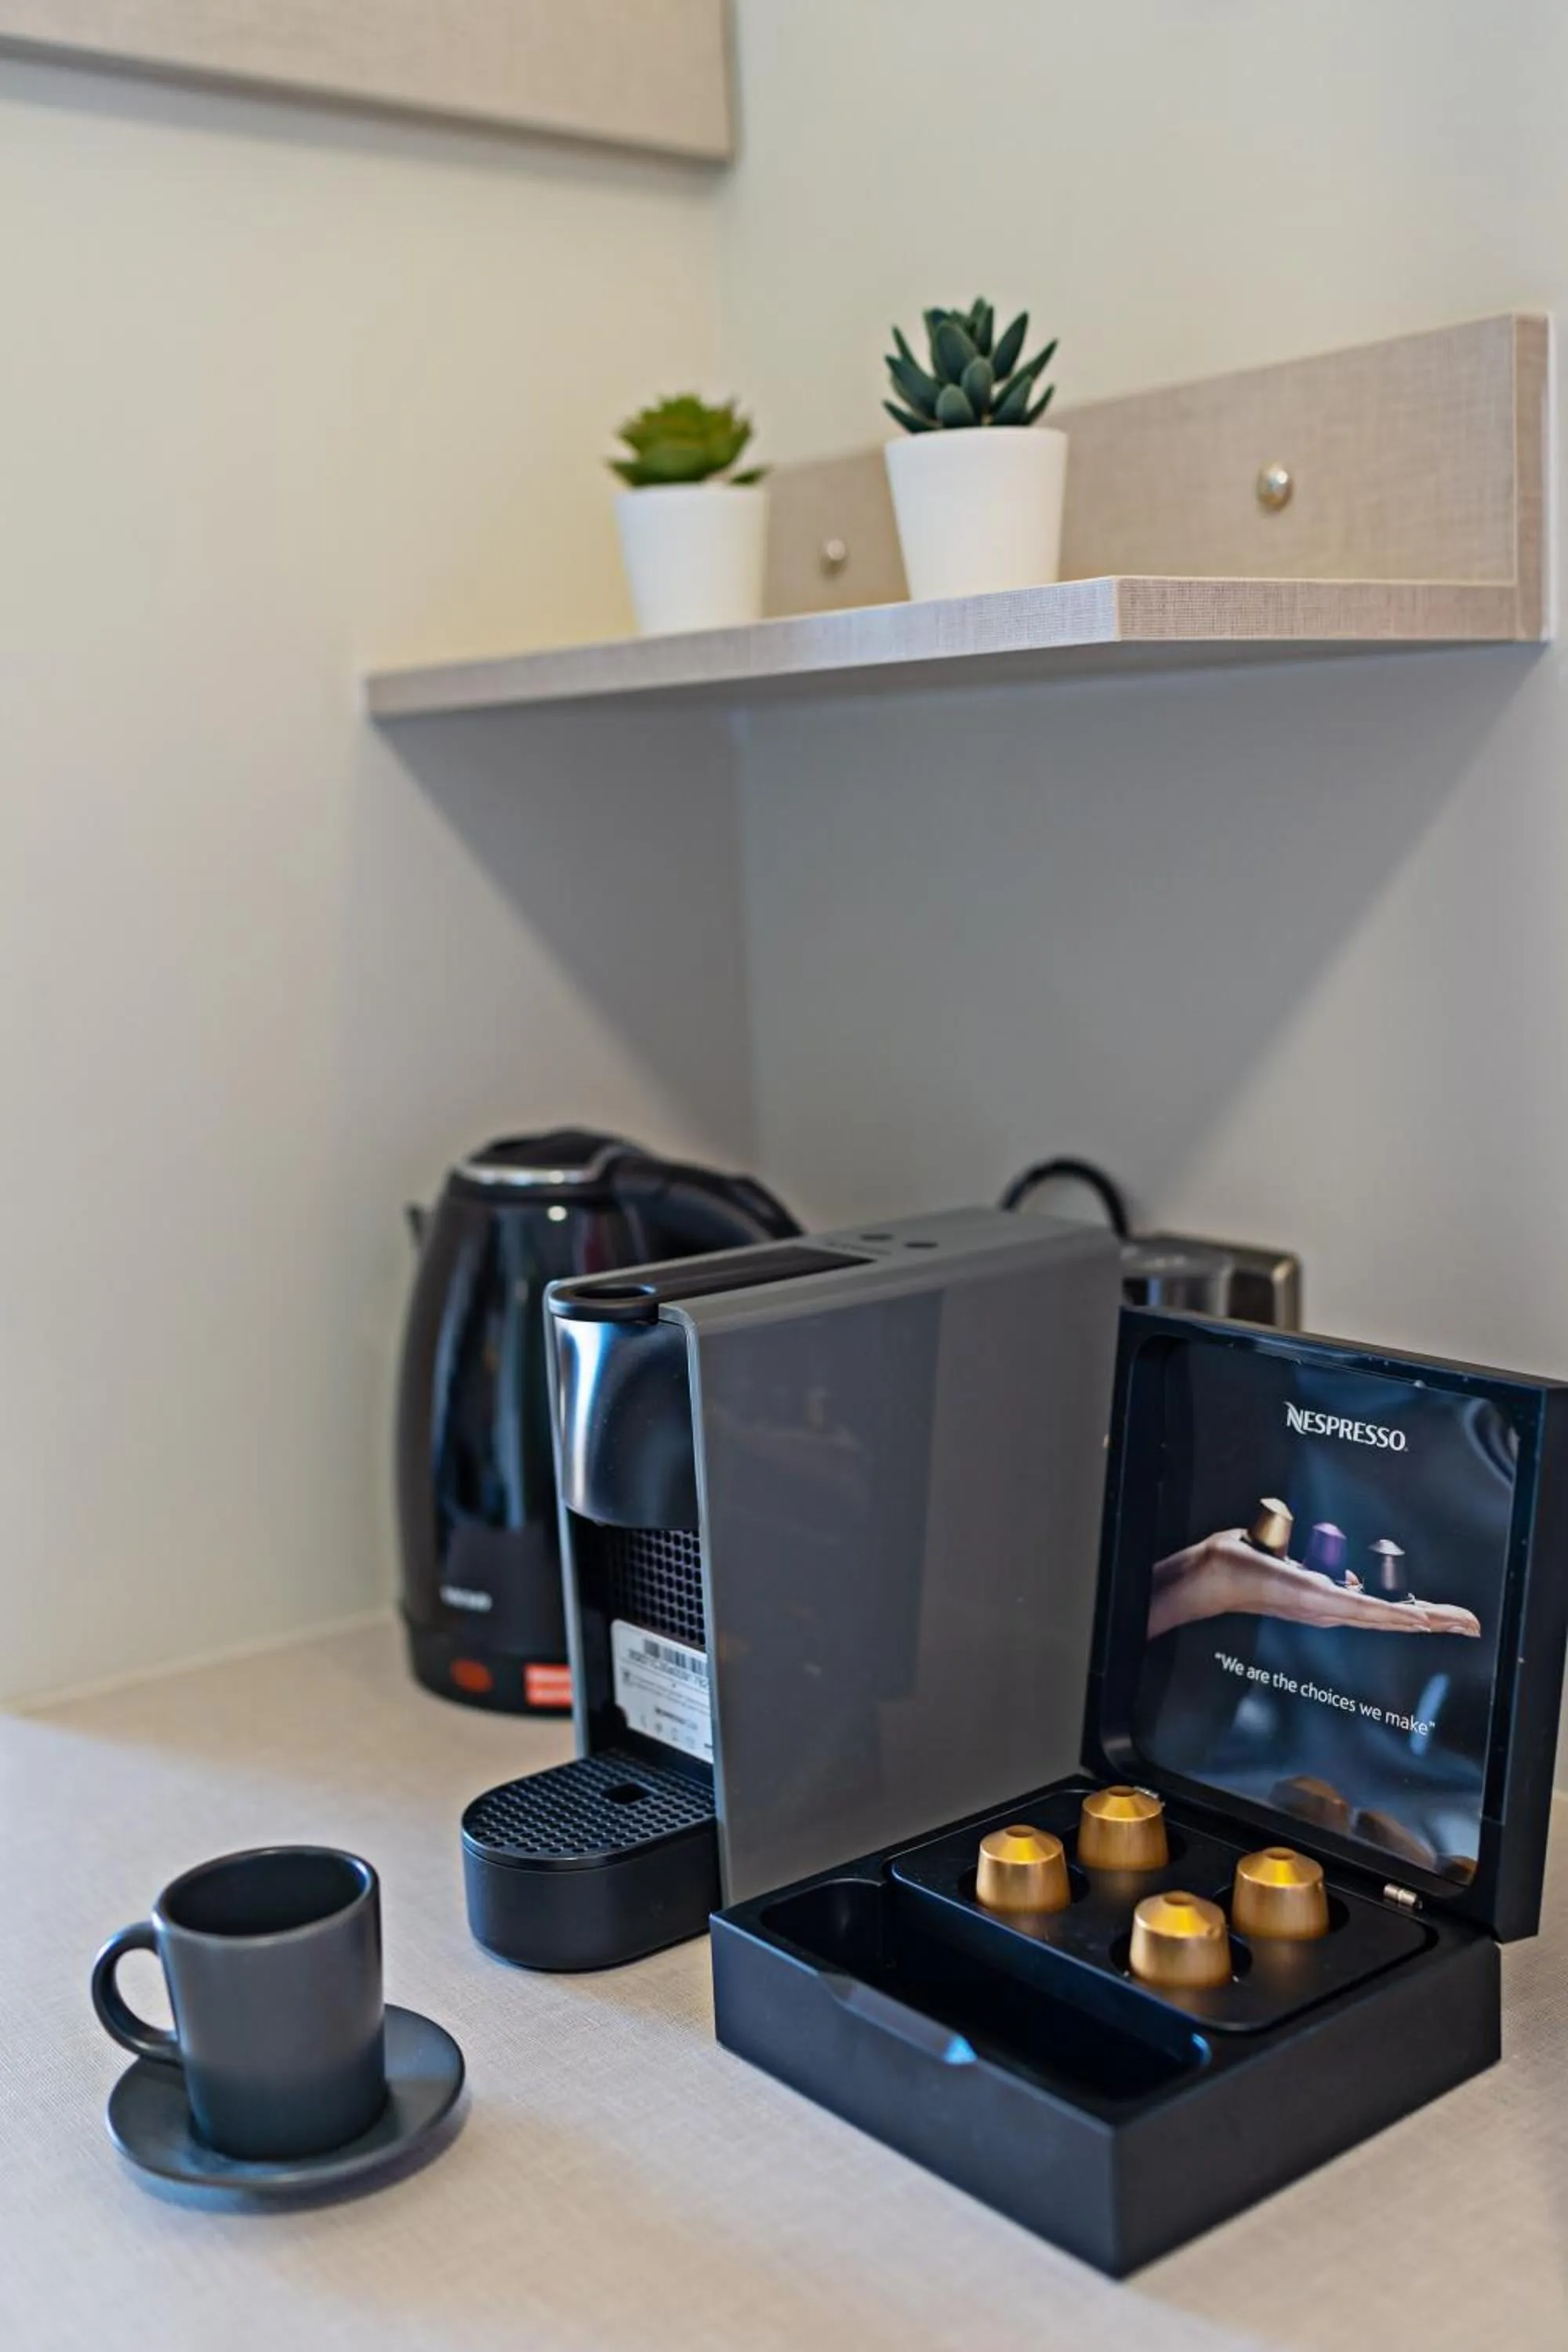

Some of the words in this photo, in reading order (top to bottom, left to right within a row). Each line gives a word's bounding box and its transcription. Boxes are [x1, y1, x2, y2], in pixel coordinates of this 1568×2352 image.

[1283, 1401, 1407, 1451] NESPRESSO
[1246, 1666, 1270, 1684] are
[1272, 1672, 1298, 1693] the
[1300, 1682, 1356, 1711] choices
[1359, 1702, 1381, 1720] we
